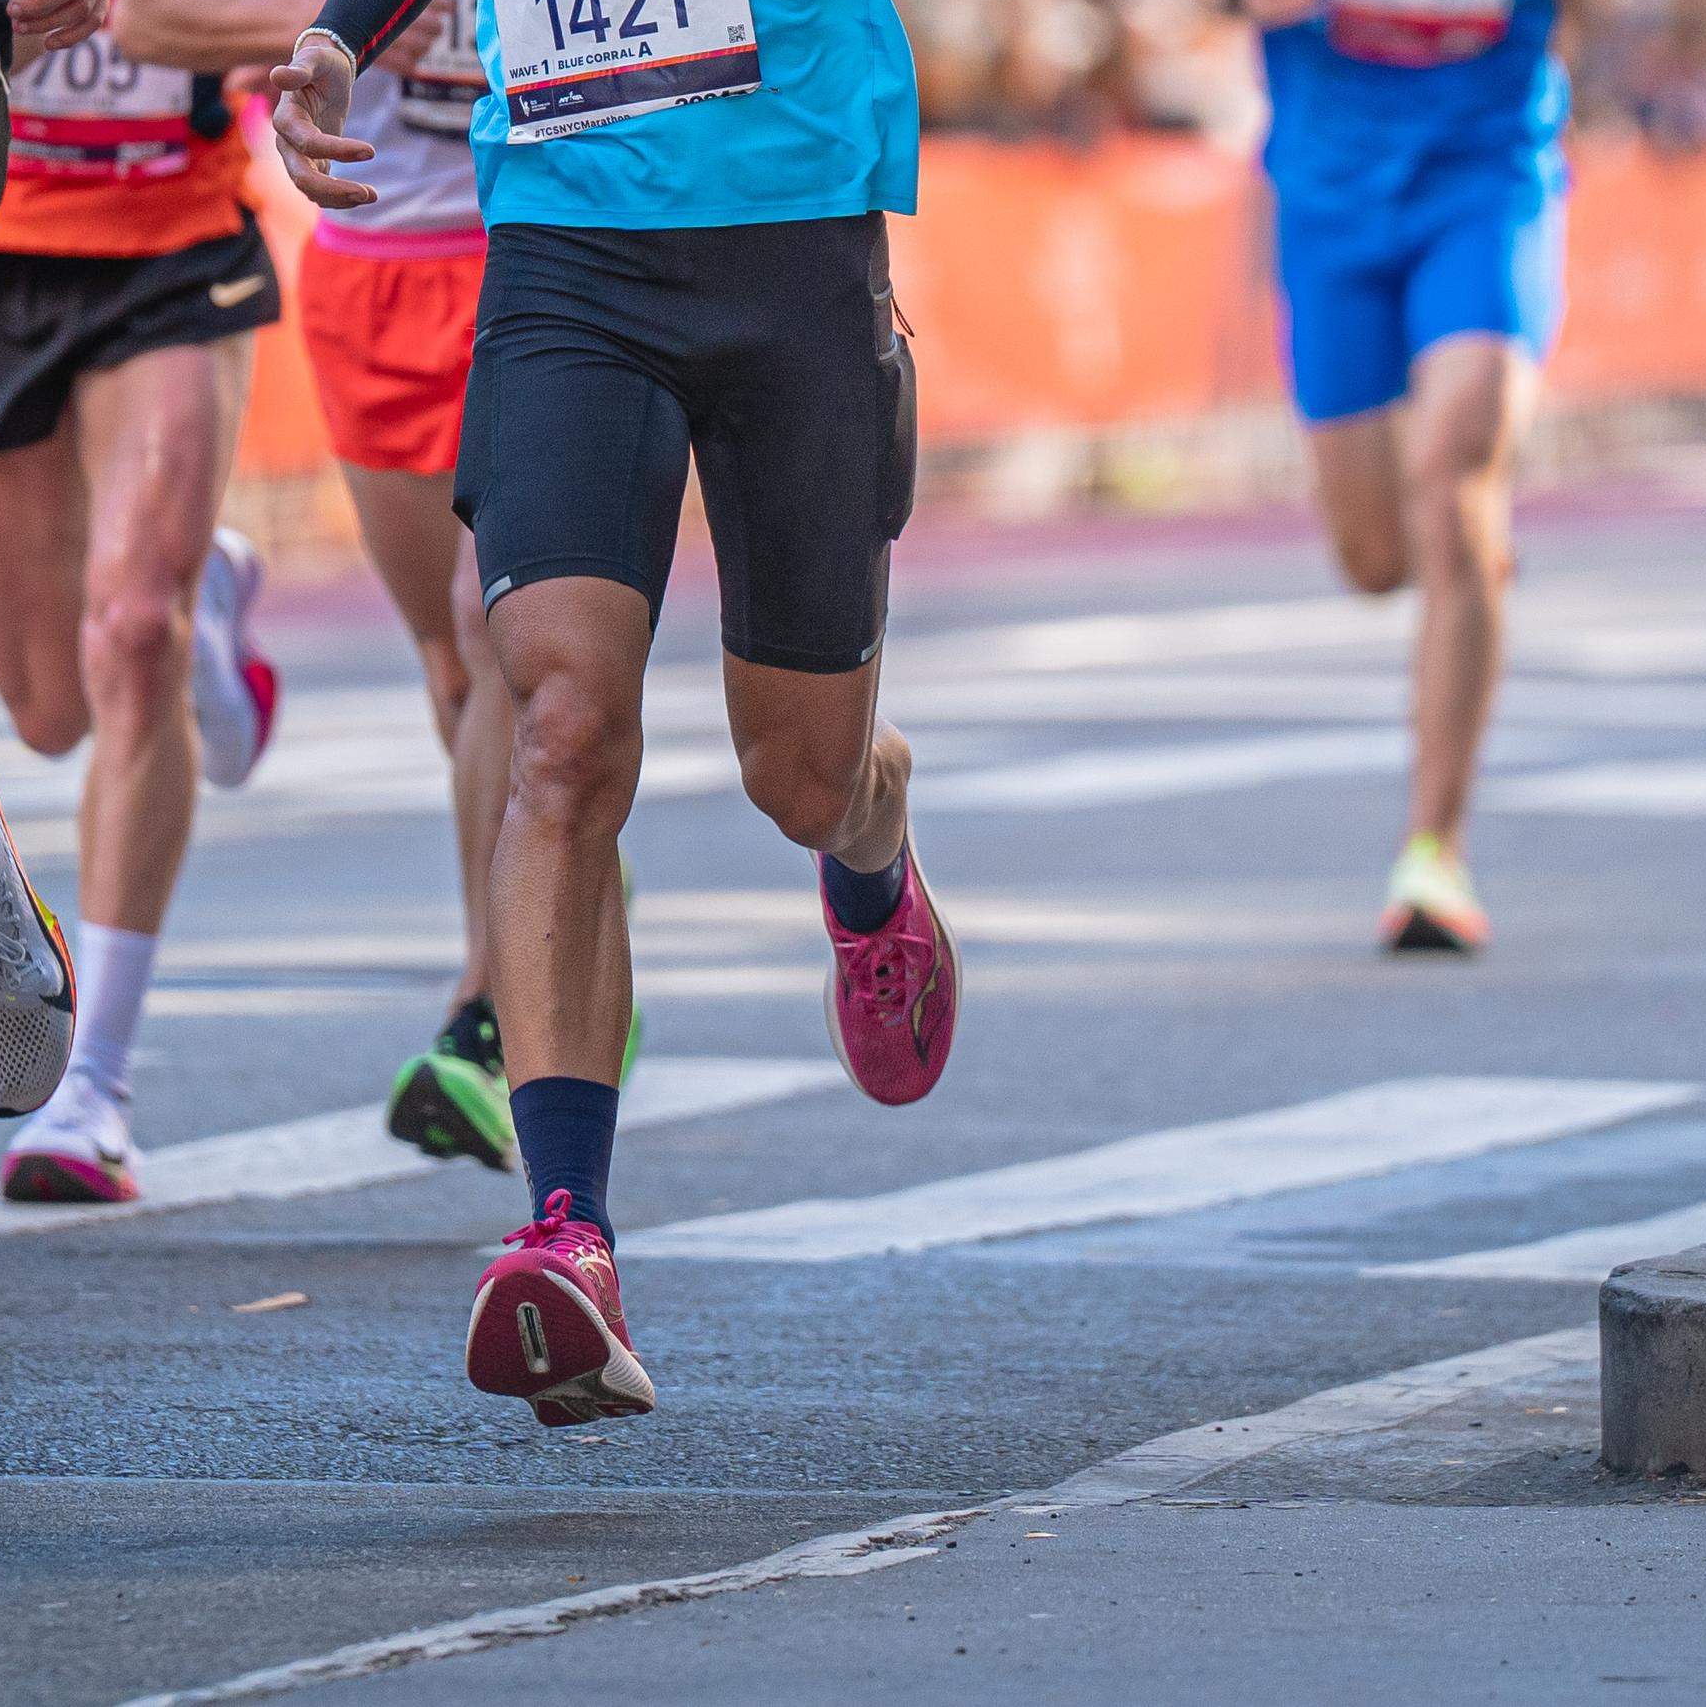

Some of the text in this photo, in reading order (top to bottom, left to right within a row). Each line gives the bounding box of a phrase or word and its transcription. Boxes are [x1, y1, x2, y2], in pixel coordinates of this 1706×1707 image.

[509, 41, 652, 79] WAVE 1 BLUE CORRAL A
[535, 114, 631, 138] #TCSNYCMarathon
